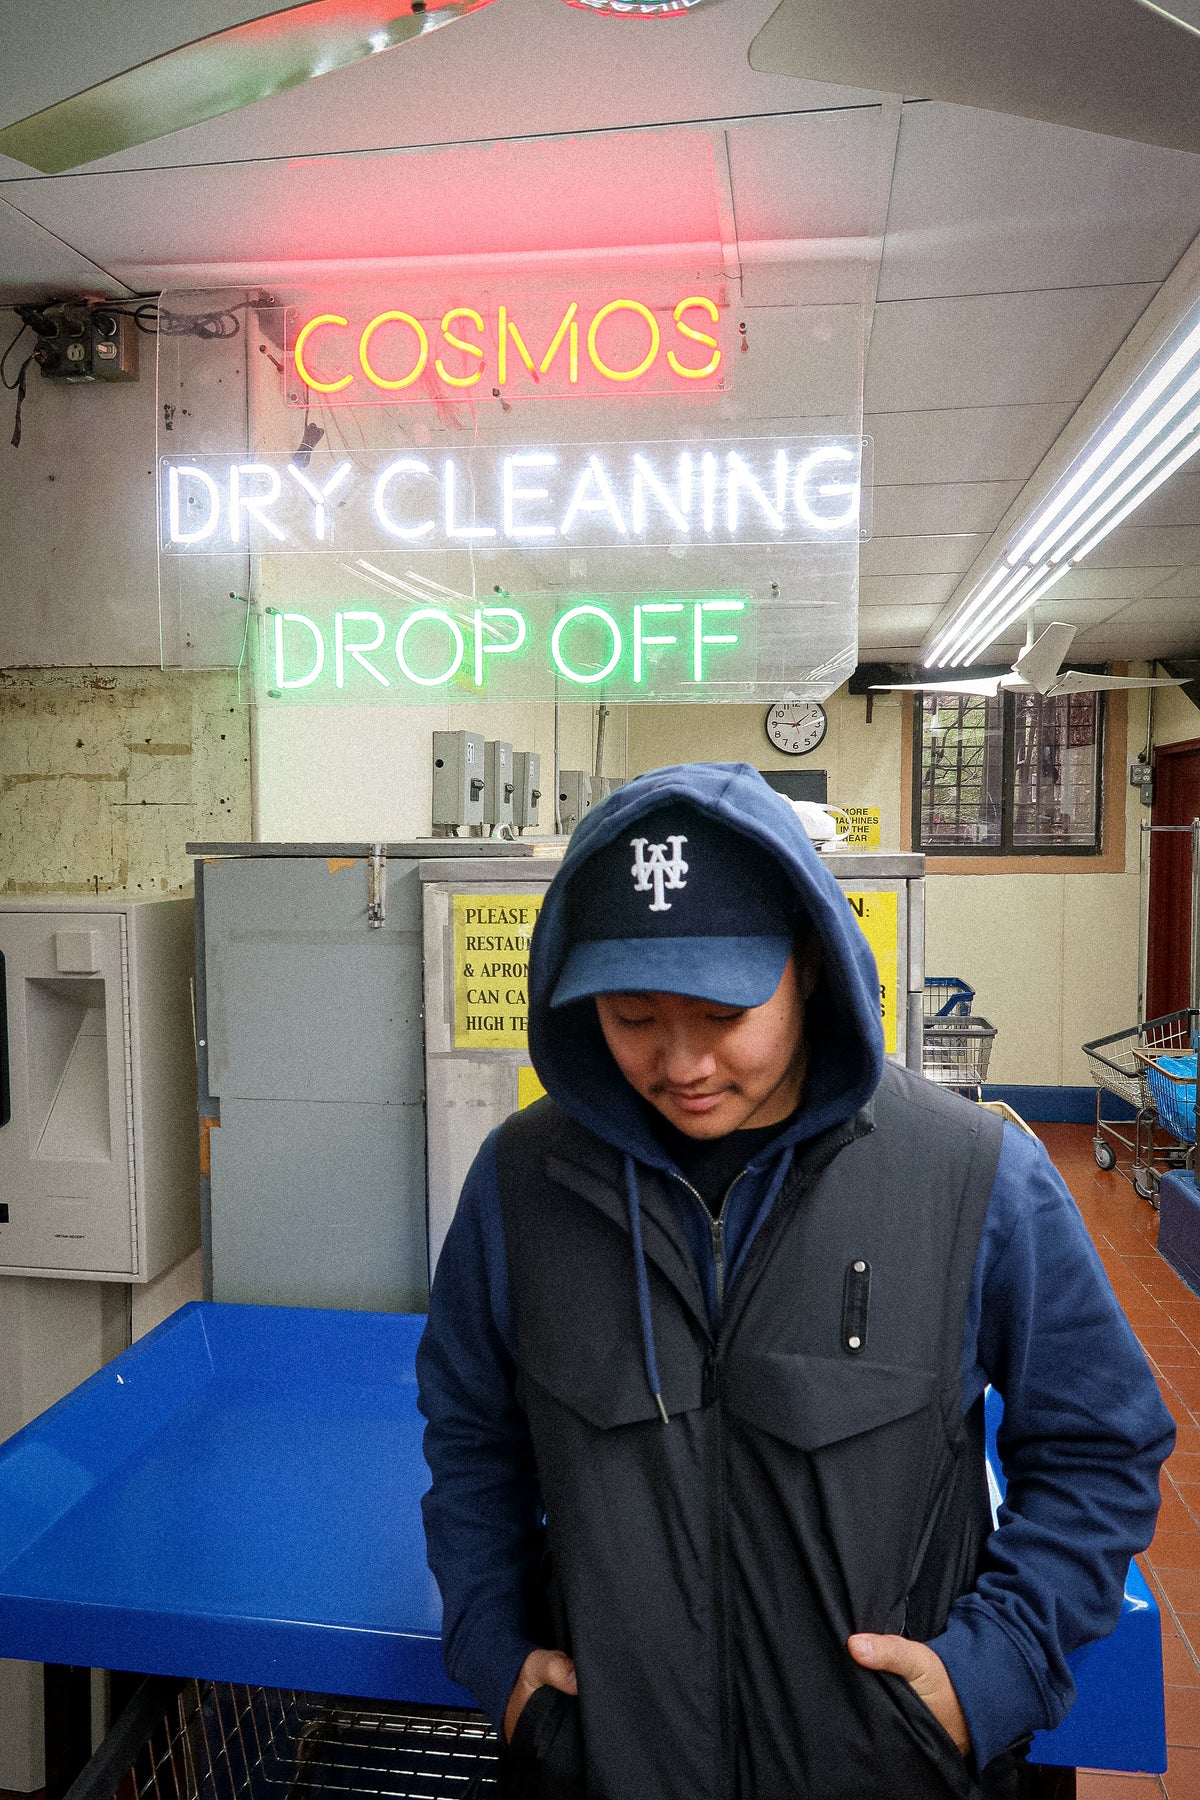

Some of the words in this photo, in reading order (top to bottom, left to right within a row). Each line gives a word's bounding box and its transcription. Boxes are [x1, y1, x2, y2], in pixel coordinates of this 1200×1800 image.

[294, 296, 722, 393] COSMOS
[169, 462, 352, 543] DRY
[373, 446, 861, 539] CLEANING
[274, 606, 527, 689] DROP
[550, 600, 746, 684] OFF
[775, 710, 785, 718] 10
[811, 710, 818, 718] 2
[774, 730, 781, 738] 8
[810, 730, 817, 738] 4
[782, 738, 789, 746] 7
[792, 741, 799, 749] 6
[804, 738, 811, 746] 5
[852, 825, 869, 833] THE
[465, 908, 529, 924] PLEASE
[463, 963, 474, 977] &
[466, 989, 500, 1004] CAN
[465, 1015, 505, 1031] HIGH
